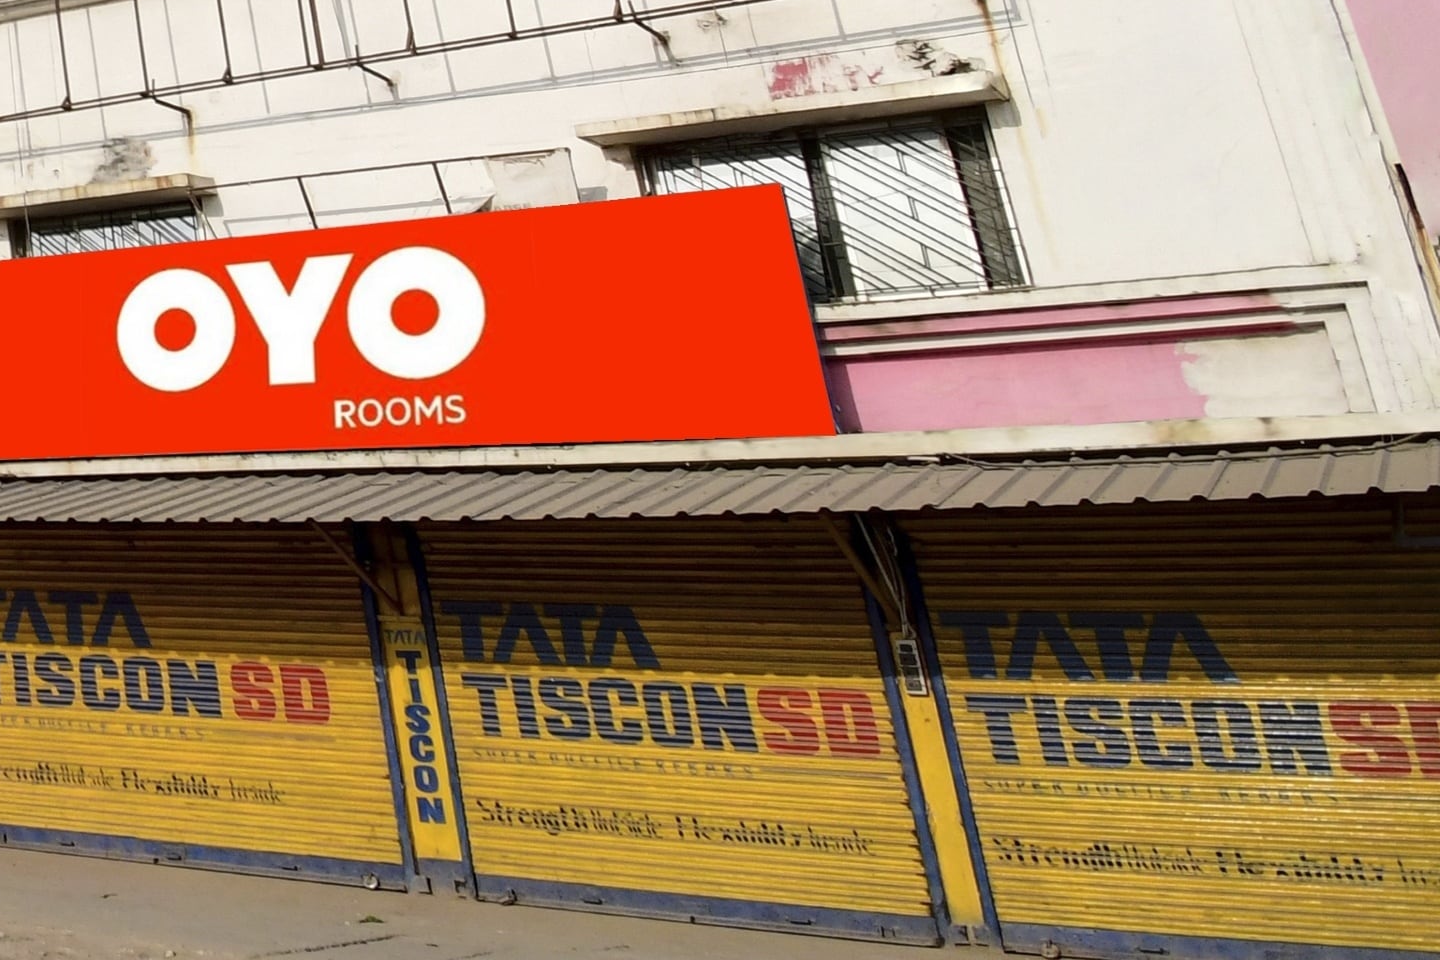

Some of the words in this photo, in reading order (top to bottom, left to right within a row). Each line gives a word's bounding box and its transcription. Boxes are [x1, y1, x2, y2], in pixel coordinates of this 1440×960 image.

[116, 245, 486, 393] OYO
[333, 394, 467, 429] ROOMS
[384, 629, 427, 645] TATA
[438, 600, 660, 668] TATA
[939, 610, 1244, 685] TATA
[229, 660, 333, 725] SD
[461, 672, 759, 753] TISCON
[756, 686, 881, 757] SD
[395, 650, 447, 825] TISCON
[965, 693, 1334, 777] TISCON
